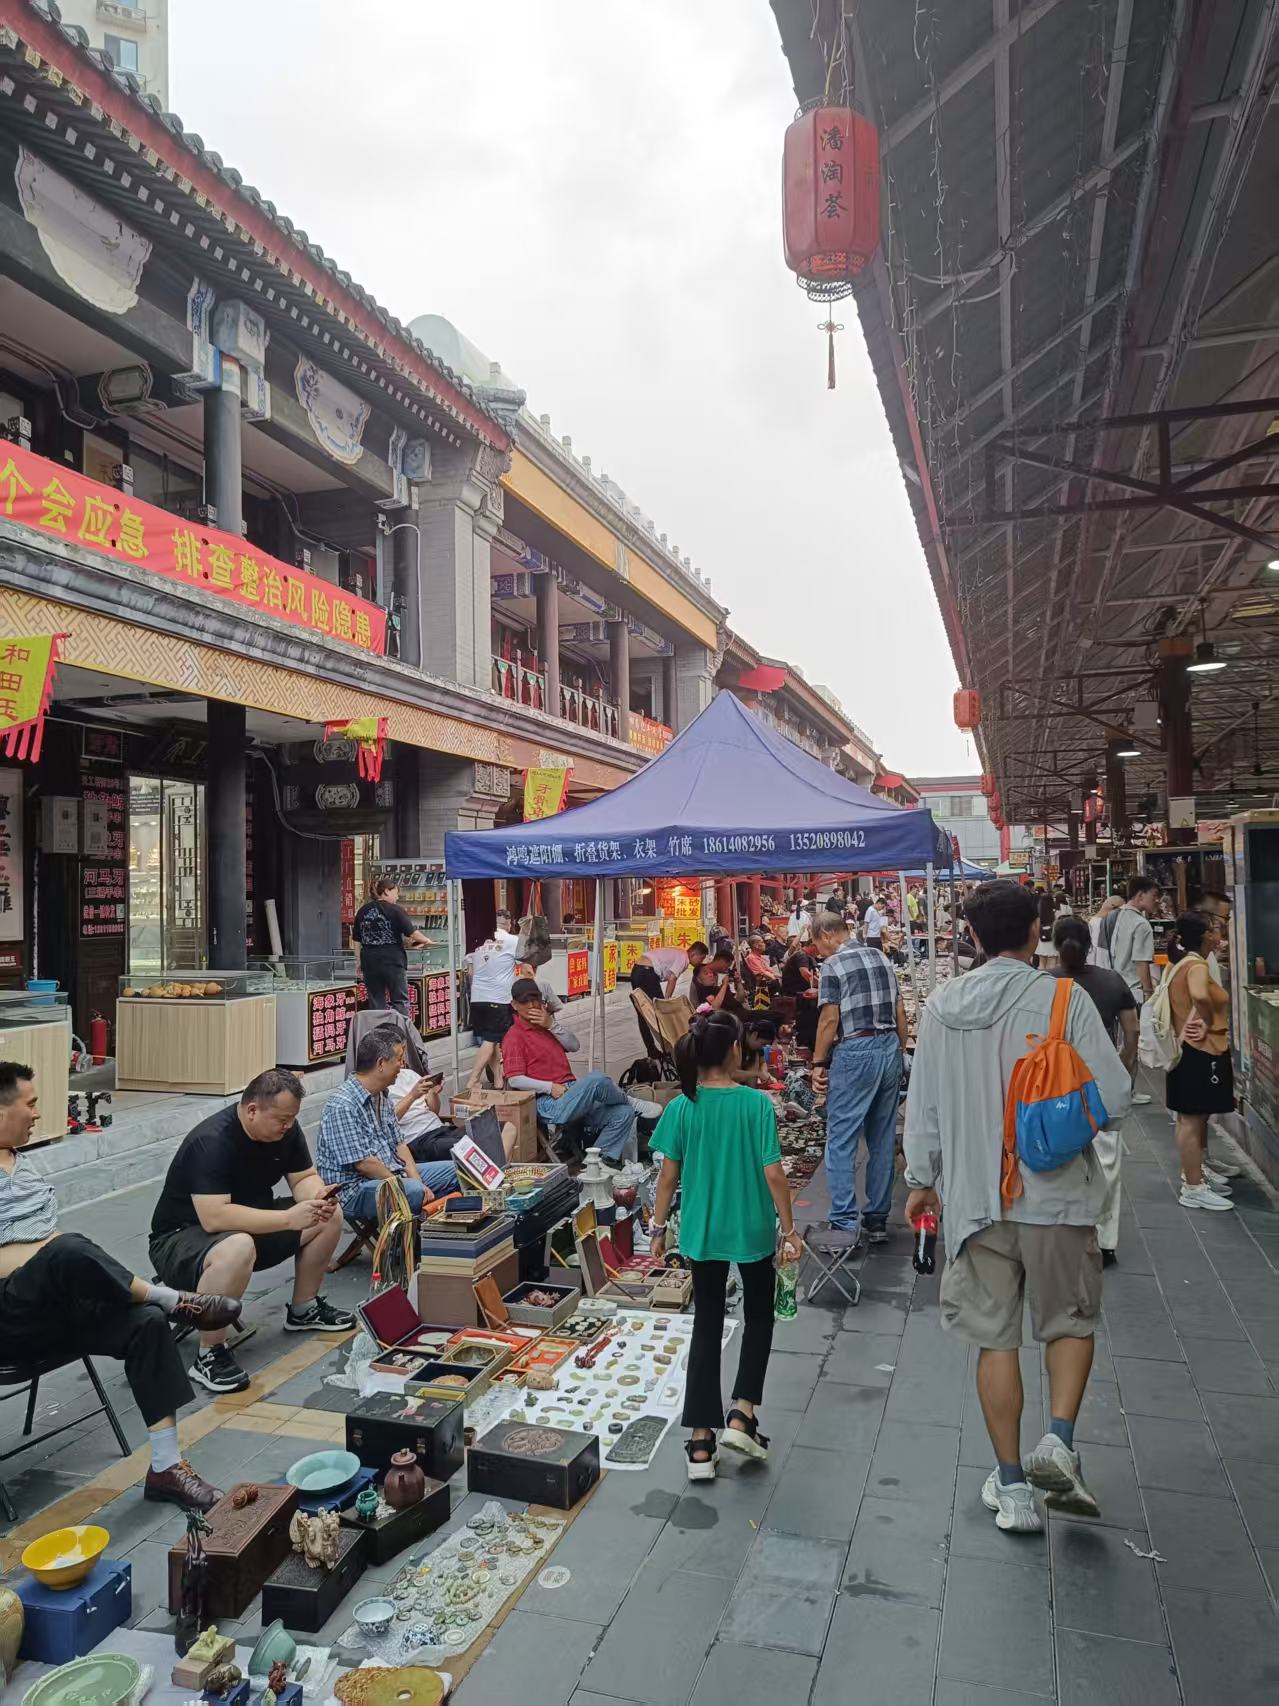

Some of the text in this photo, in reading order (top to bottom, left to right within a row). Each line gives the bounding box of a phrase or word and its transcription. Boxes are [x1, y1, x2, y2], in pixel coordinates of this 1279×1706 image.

[820, 126, 848, 218] 潘淘荟
[0, 457, 370, 648] 个会应急 排查整治风险隐患
[0, 643, 31, 721] 和田玉
[669, 835, 692, 857] 竹席
[704, 834, 775, 854] 18614082956
[789, 830, 866, 850] 13520898042
[313, 992, 346, 1010] 海象牙
[313, 1006, 346, 1025] 独角鲸
[313, 1020, 346, 1040] 猛犸牙
[313, 1035, 346, 1055] 河马牙
